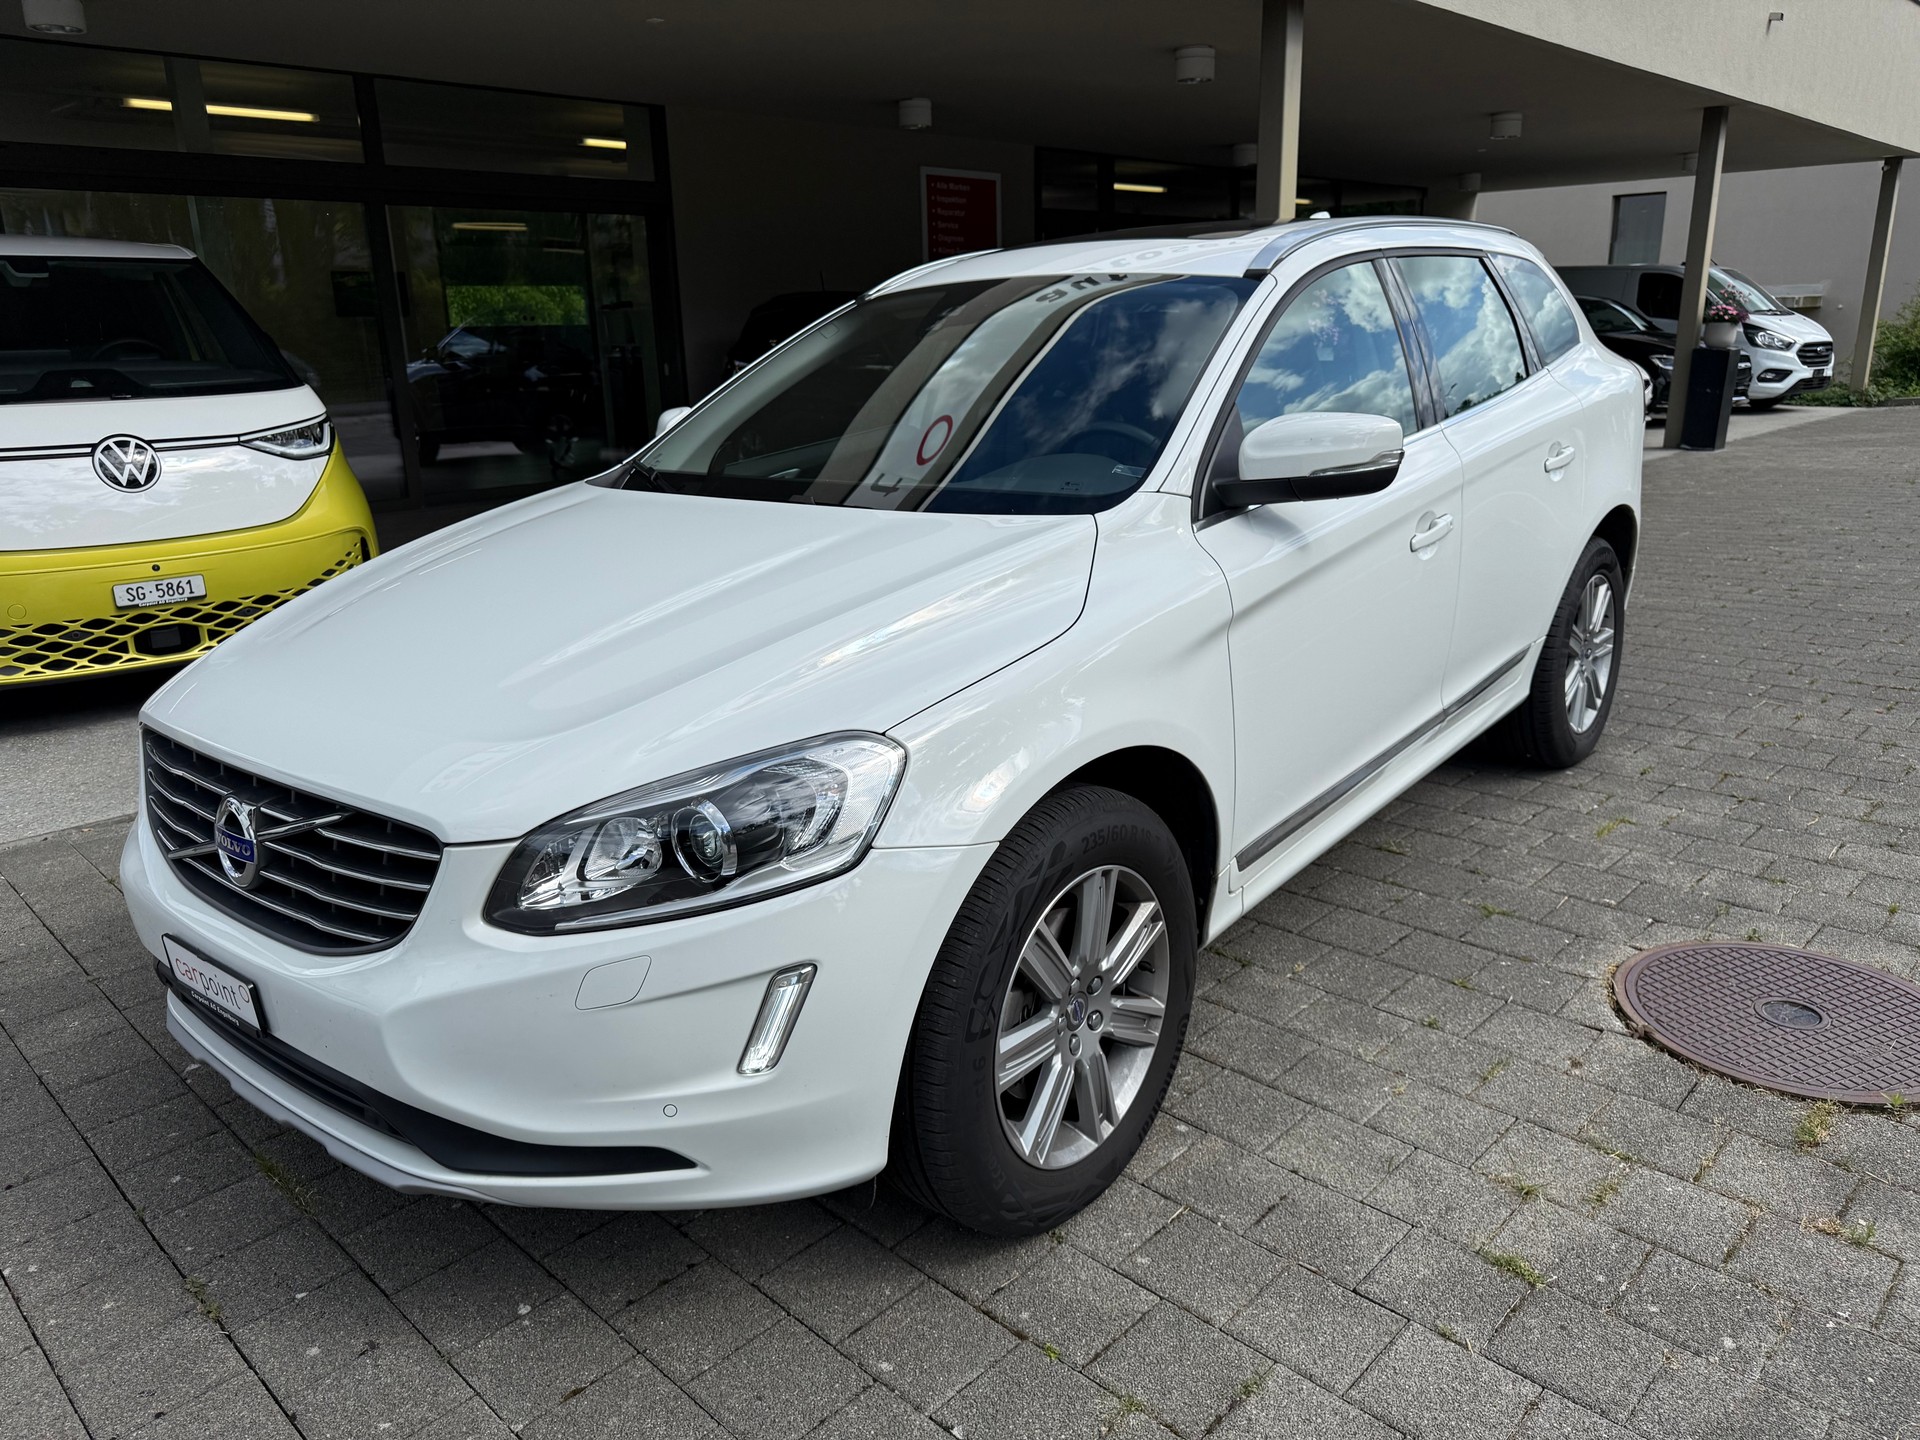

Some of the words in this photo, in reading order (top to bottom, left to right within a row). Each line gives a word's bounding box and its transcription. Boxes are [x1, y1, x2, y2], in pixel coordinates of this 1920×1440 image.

[216, 832, 252, 857] VOLVO
[1080, 824, 1127, 855] 235/60
[175, 957, 242, 1010] carpoint
